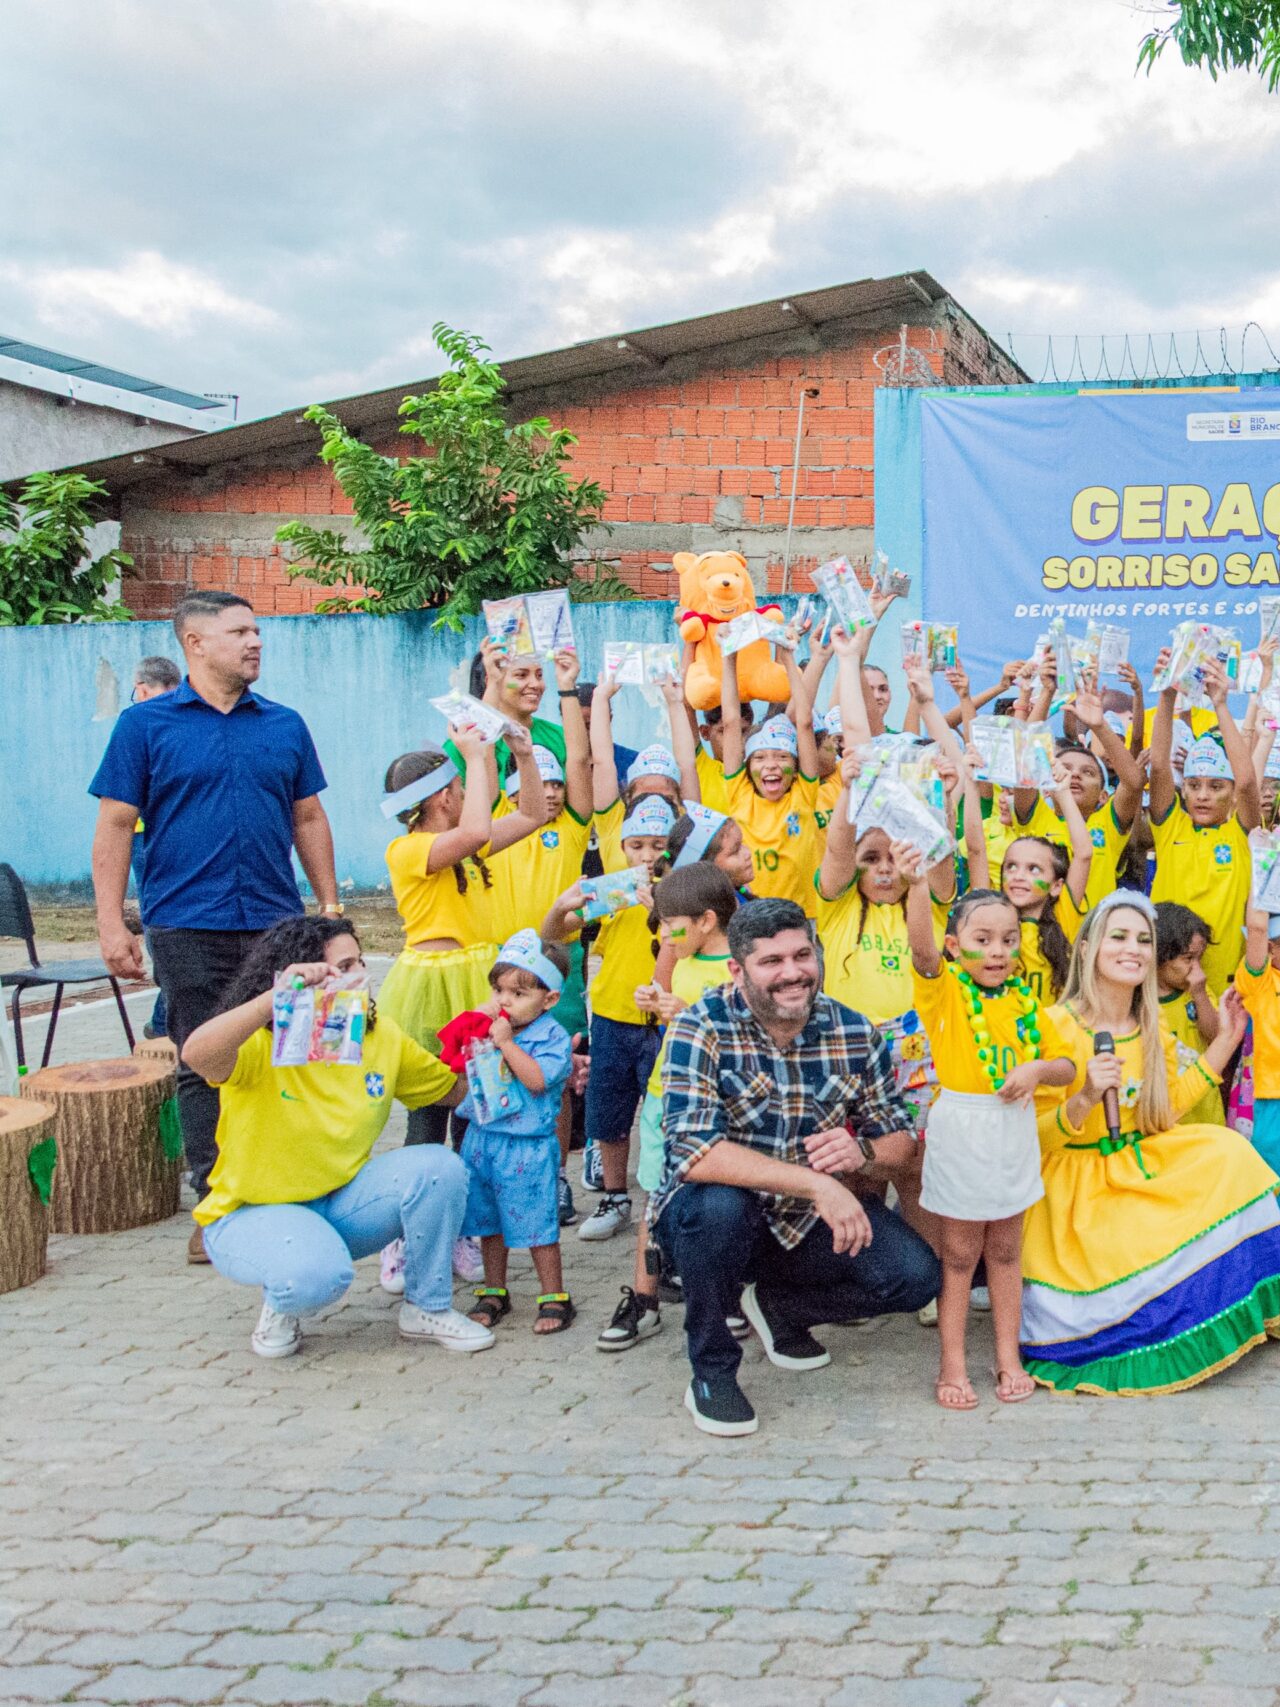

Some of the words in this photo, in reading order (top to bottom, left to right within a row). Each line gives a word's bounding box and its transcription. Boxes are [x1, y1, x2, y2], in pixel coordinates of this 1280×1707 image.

[1042, 552, 1219, 591] SORRISO
[1014, 602, 1127, 618] DENTINHOS
[1132, 601, 1208, 616] FORTES
[1214, 601, 1227, 615] E
[754, 848, 780, 872] 10
